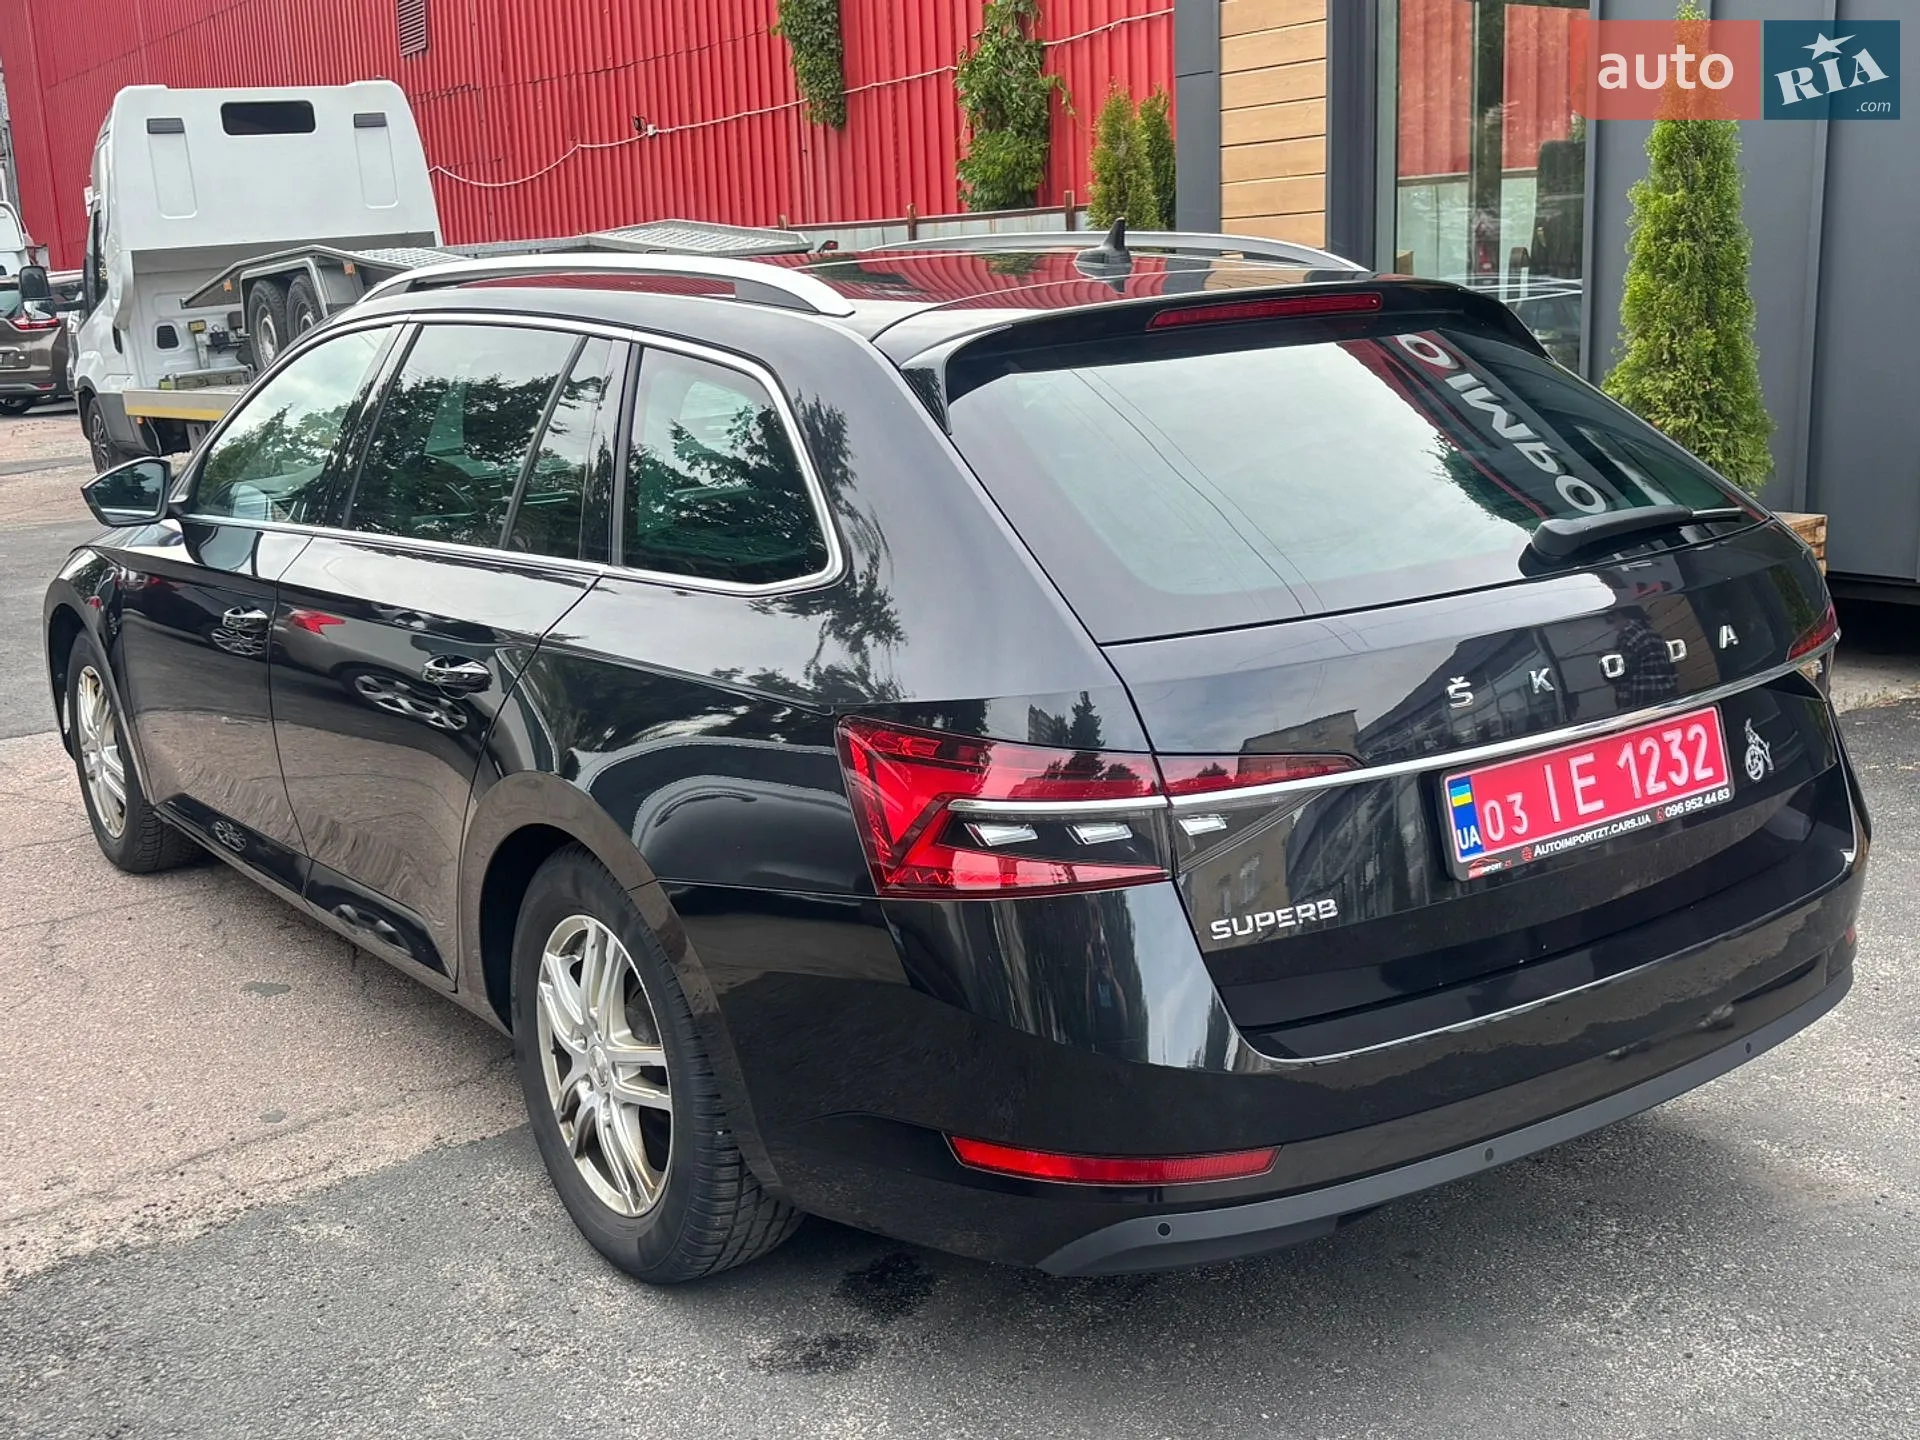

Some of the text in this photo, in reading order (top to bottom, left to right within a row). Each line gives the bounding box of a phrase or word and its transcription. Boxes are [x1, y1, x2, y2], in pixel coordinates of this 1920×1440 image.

[1446, 625, 1739, 708] ŠKODA
[1483, 723, 1714, 842] 03 IE 1232
[1665, 802, 1684, 817] 096
[1685, 797, 1704, 812] 952
[1704, 792, 1717, 804] 44
[1456, 825, 1481, 850] UA
[1210, 898, 1339, 940] SUPERB
